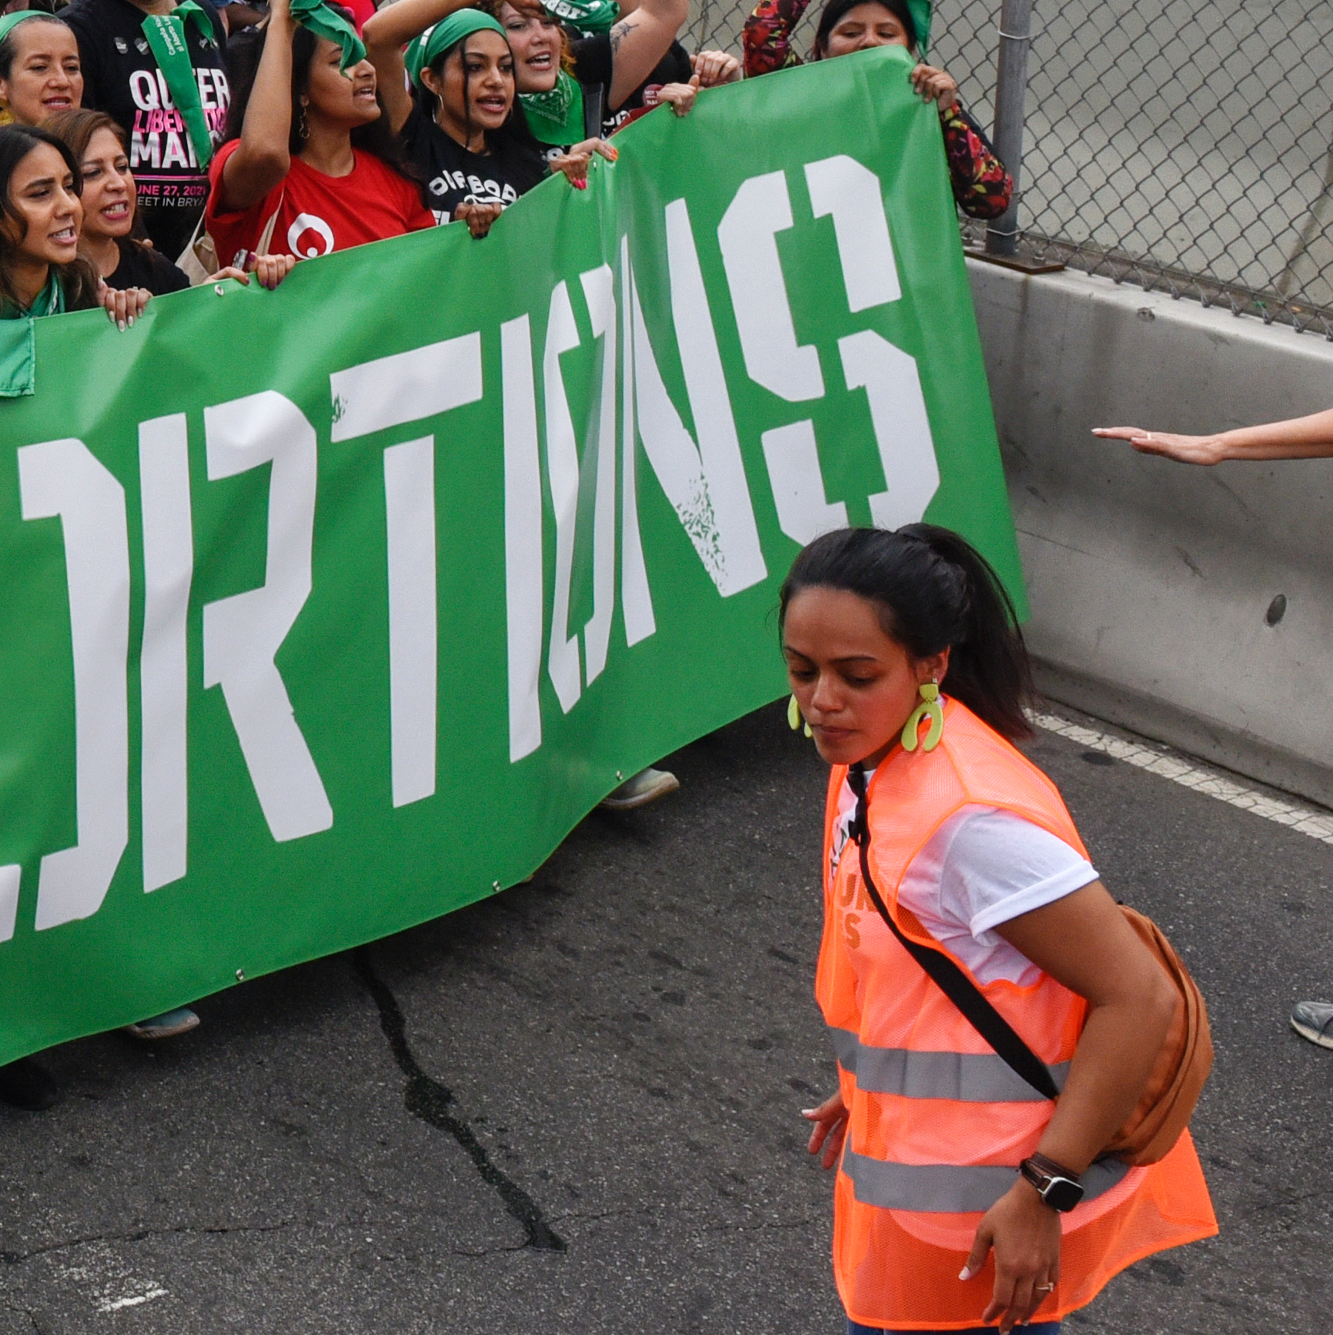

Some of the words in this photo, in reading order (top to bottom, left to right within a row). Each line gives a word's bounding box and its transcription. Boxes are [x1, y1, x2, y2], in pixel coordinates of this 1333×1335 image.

[129, 68, 231, 111] QUER
[137, 185, 160, 196] UNE
[164, 185, 180, 197] 27,
[137, 197, 160, 206] EET
[162, 197, 175, 207] IN
